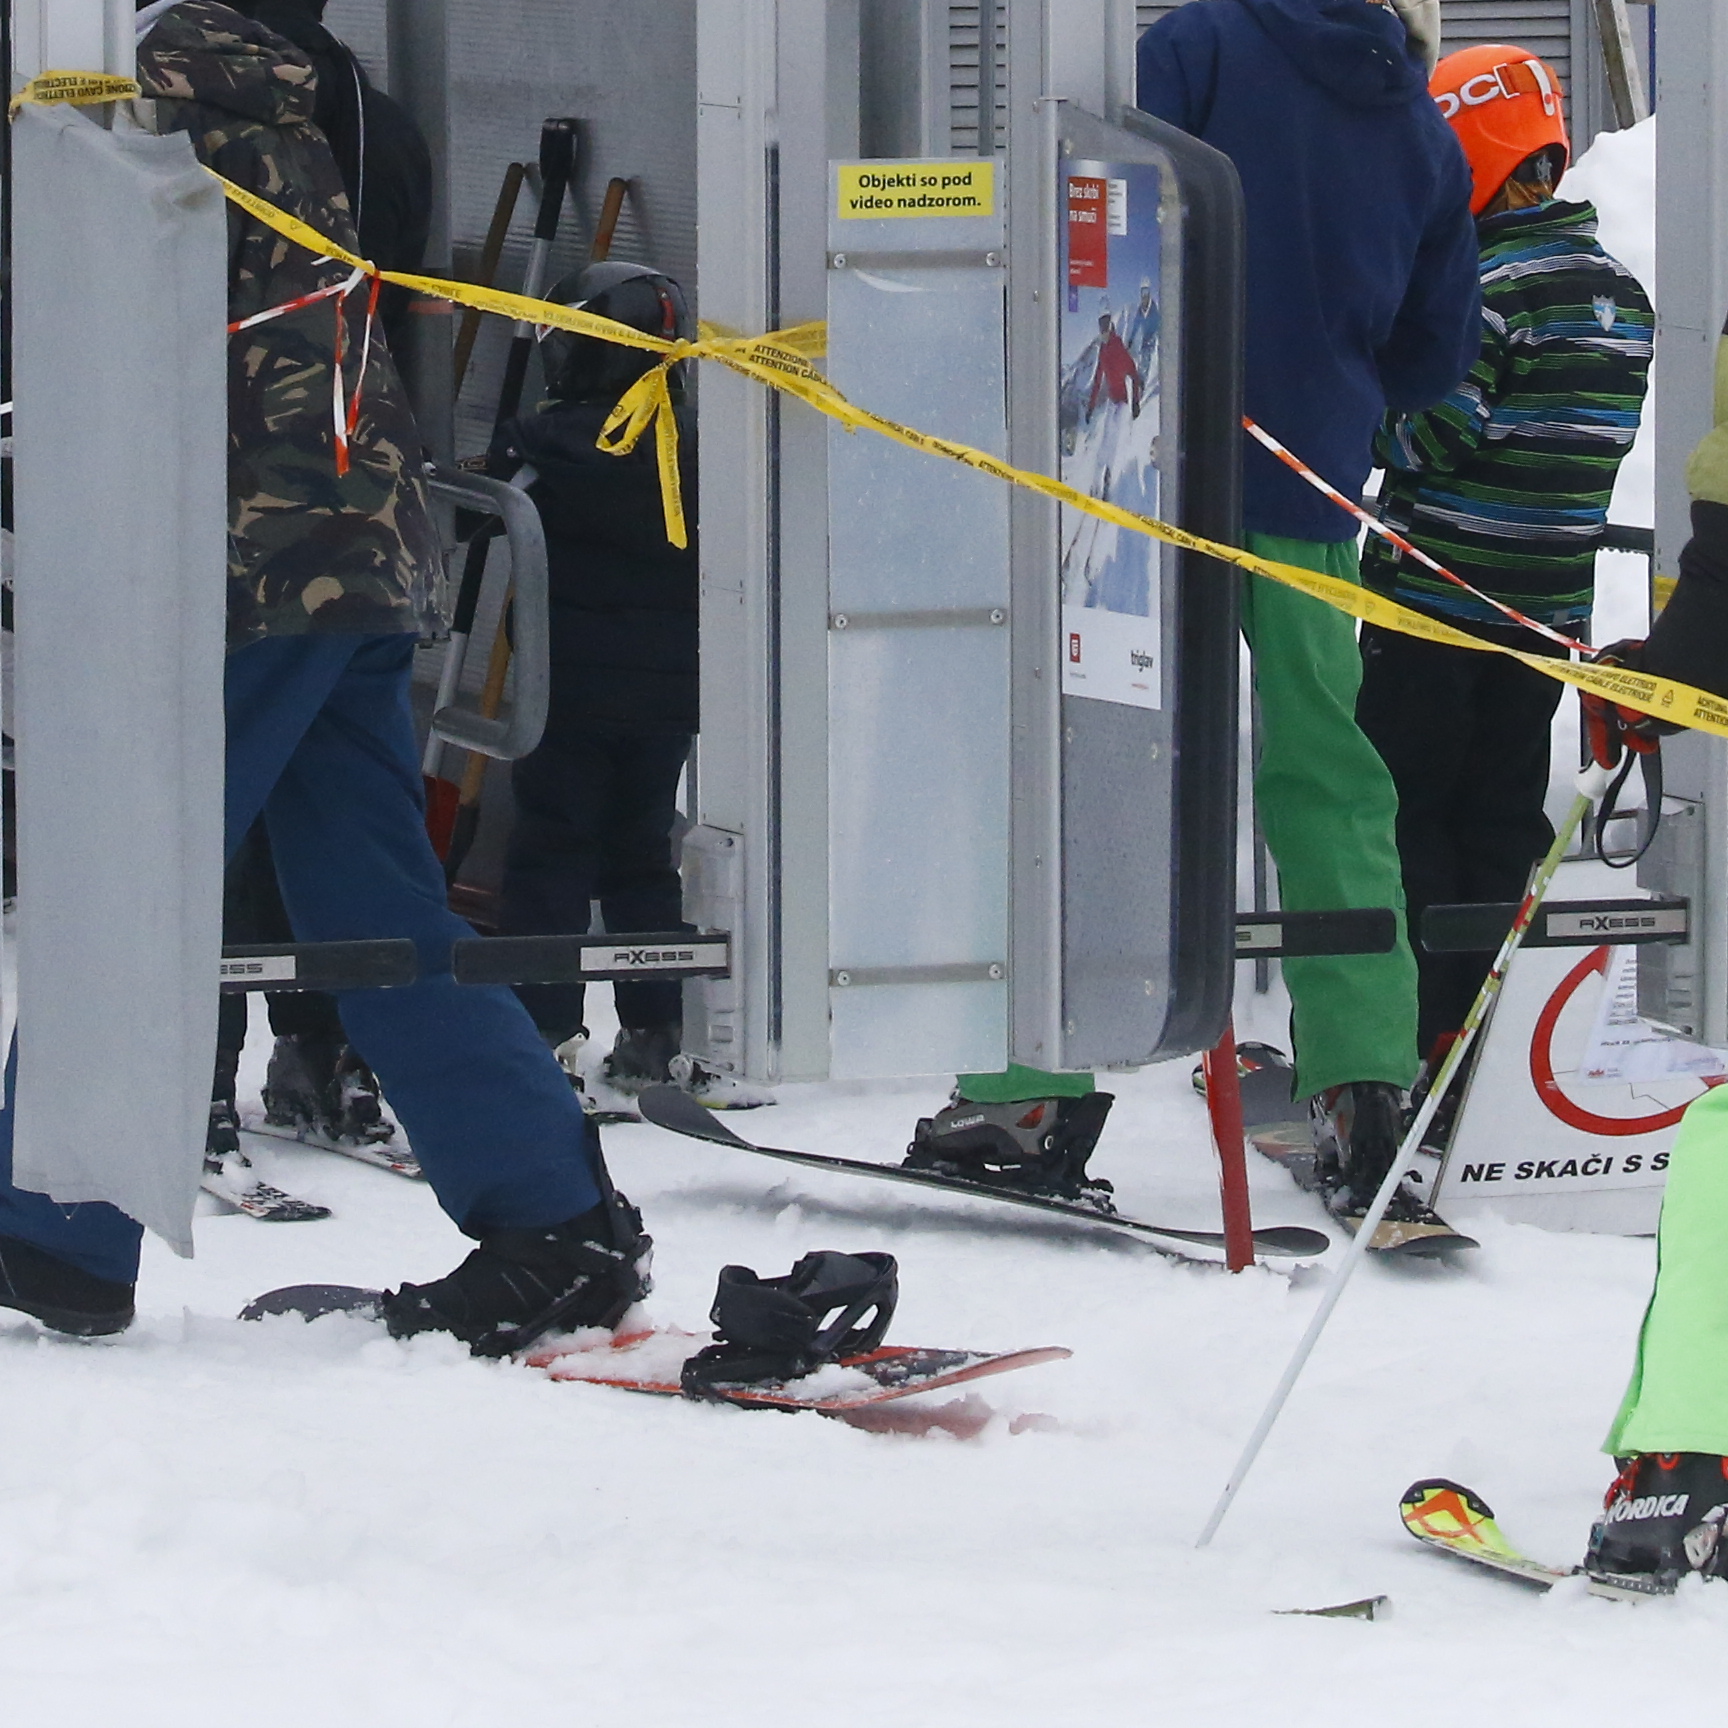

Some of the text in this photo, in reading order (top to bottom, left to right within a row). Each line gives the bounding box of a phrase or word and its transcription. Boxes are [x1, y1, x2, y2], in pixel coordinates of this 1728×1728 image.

[859, 172, 971, 191] Objekti so pod
[850, 194, 981, 209] video nadzorom.
[1580, 916, 1655, 930] AXESS
[615, 950, 693, 964] AXESS
[1461, 1163, 1506, 1182] NE
[1514, 1153, 1613, 1180] SKAČI
[1622, 1155, 1642, 1173] S
[1605, 1494, 1689, 1525] NORDICA
